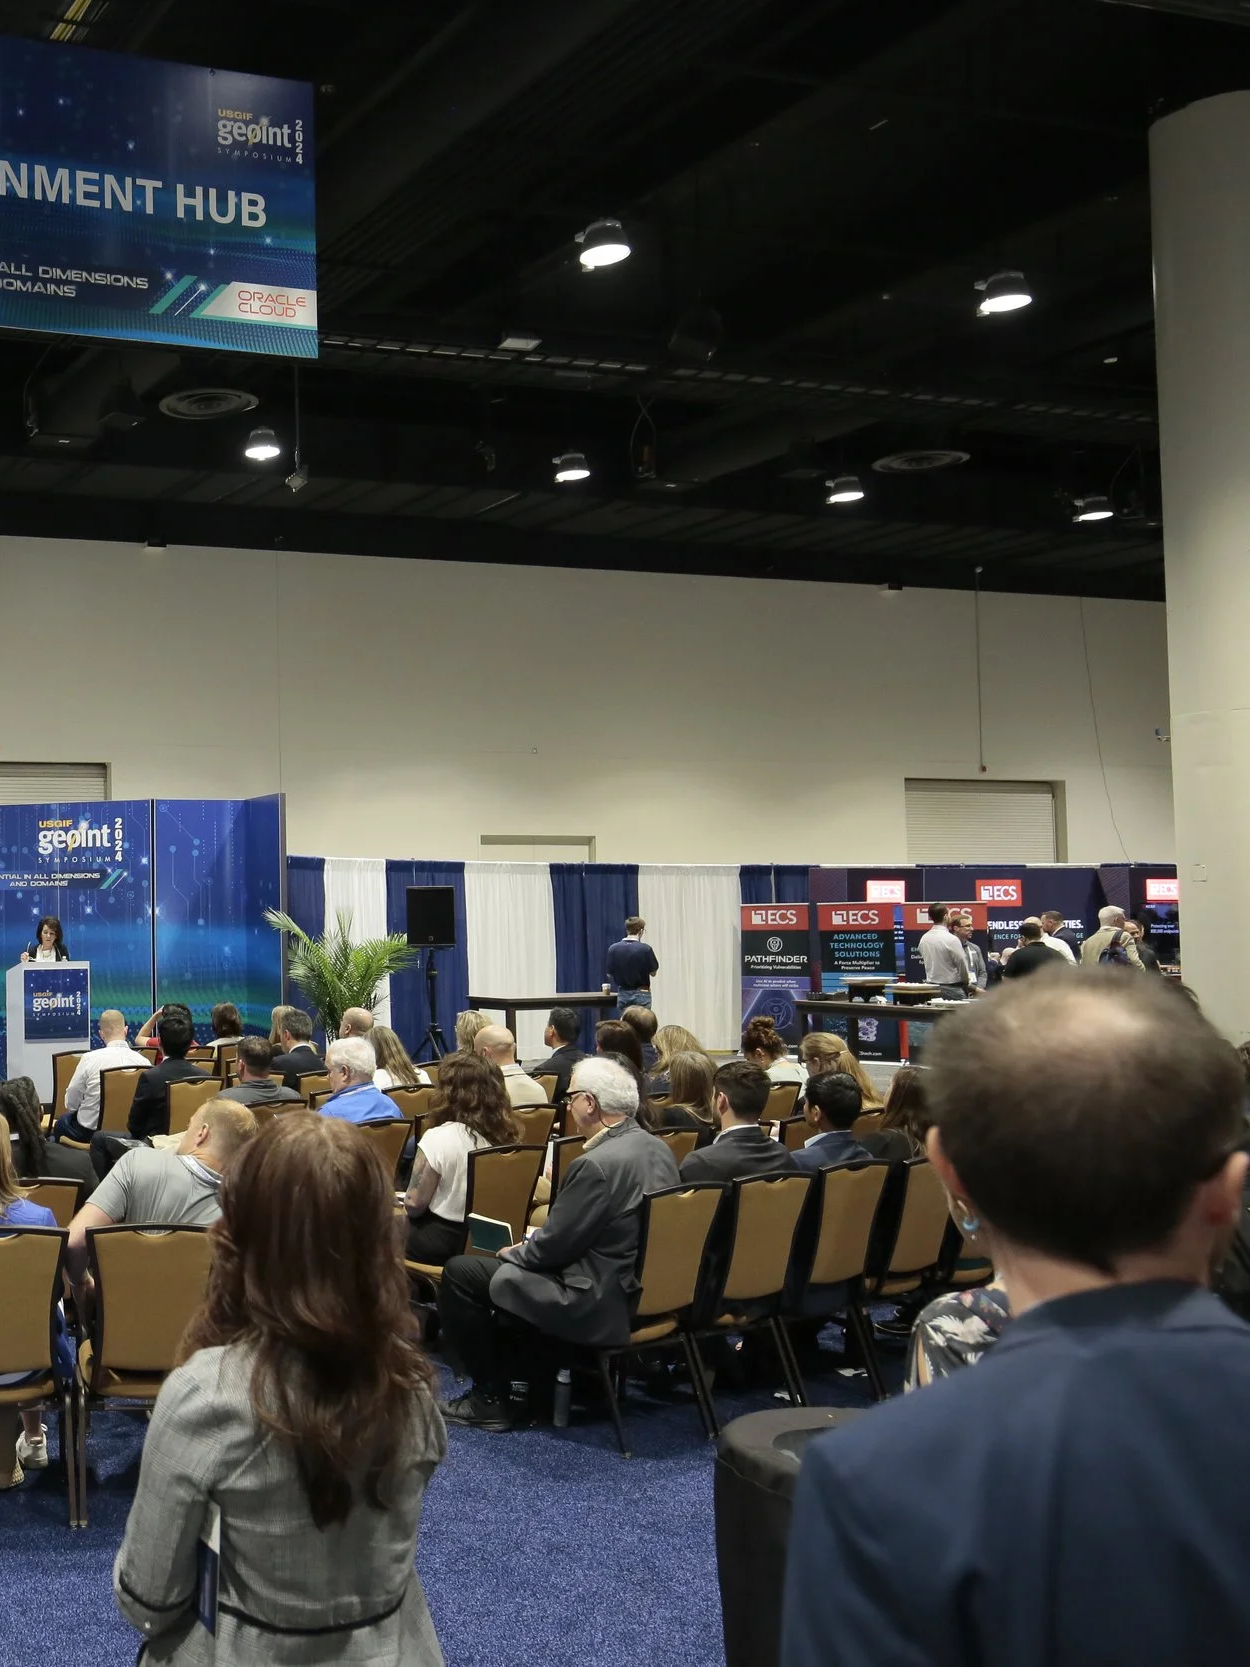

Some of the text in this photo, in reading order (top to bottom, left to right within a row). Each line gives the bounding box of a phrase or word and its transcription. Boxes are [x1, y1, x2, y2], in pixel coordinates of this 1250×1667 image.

[218, 108, 253, 120] USGIF
[295, 120, 303, 164] 2024
[217, 147, 291, 162] SYMPOSIUM
[176, 183, 266, 228] HUB
[39, 266, 149, 289] DIMENSIONS
[238, 290, 306, 307] ORACLE
[238, 303, 296, 318] CLOUD
[39, 820, 73, 828] USGIF
[38, 824, 111, 854] geoint
[114, 818, 123, 862] 2024
[994, 886, 1017, 900] ECS
[768, 910, 797, 925] ECS
[848, 910, 879, 925] ECS
[744, 955, 808, 963] PATHFINDER
[33, 995, 75, 1012] geoint
